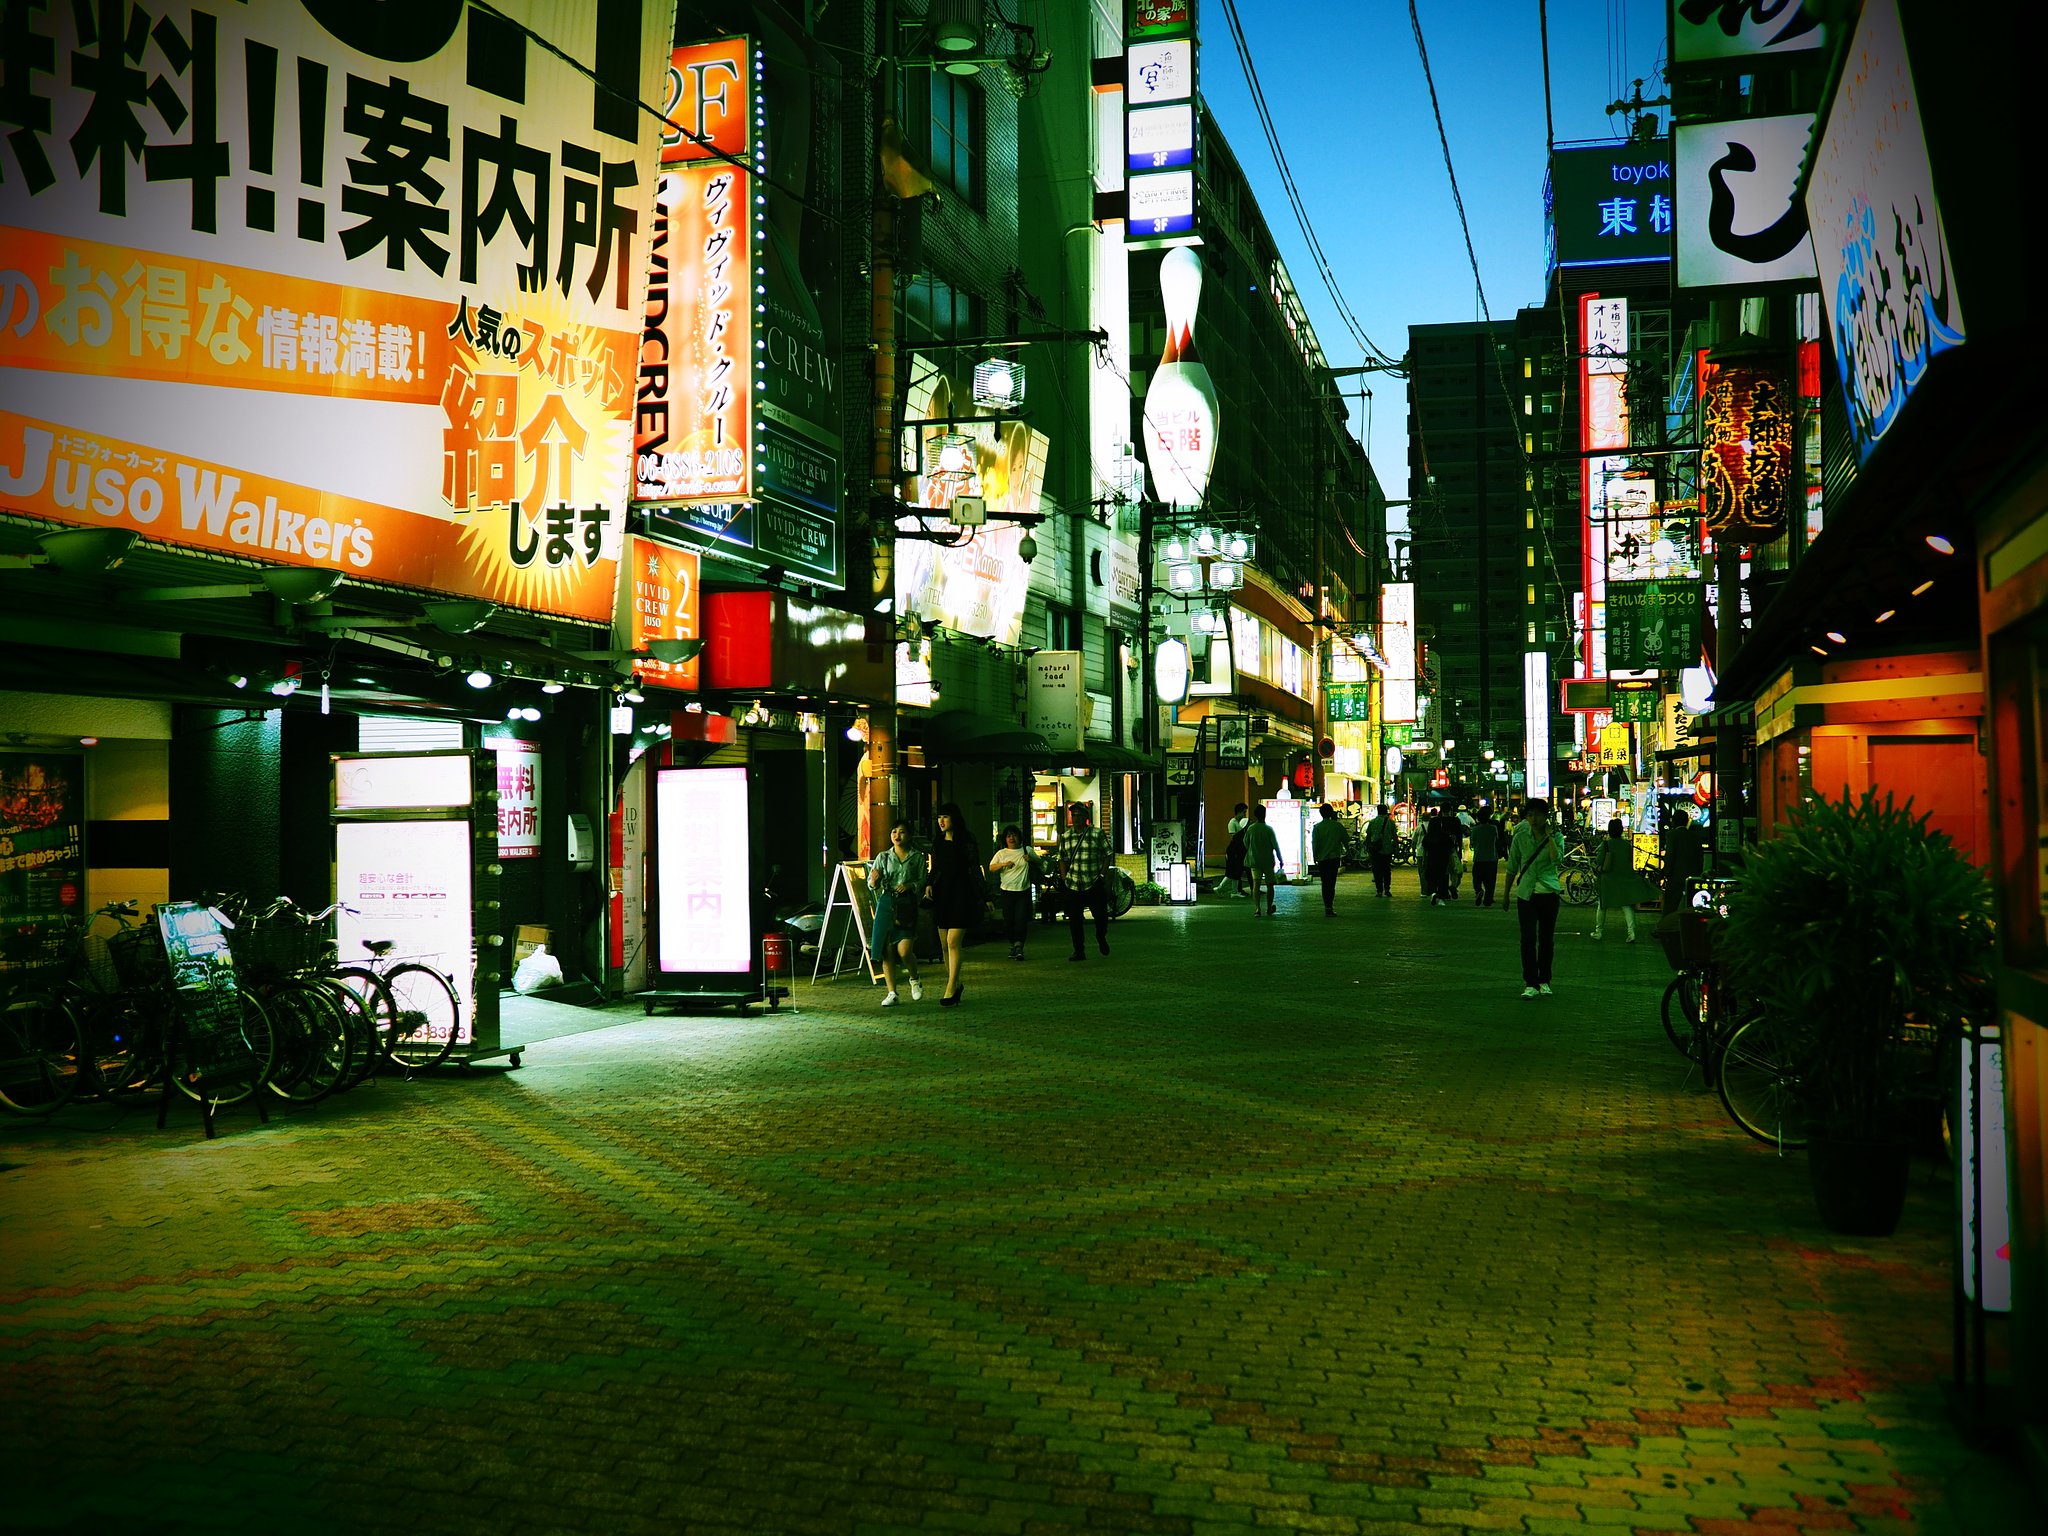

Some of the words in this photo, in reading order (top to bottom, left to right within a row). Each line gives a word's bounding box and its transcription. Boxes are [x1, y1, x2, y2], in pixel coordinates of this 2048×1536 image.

[1153, 152, 1168, 166] 3F
[1154, 217, 1169, 232] 3F
[441, 362, 589, 525] 紹介
[508, 502, 611, 568] します
[801, 526, 827, 548] CREW
[636, 580, 670, 601] VIVID
[1608, 591, 1696, 607] きれいなまちづくり
[635, 597, 669, 616] CREW
[644, 614, 661, 628] JUSO
[1622, 621, 1631, 661] サカエマチ
